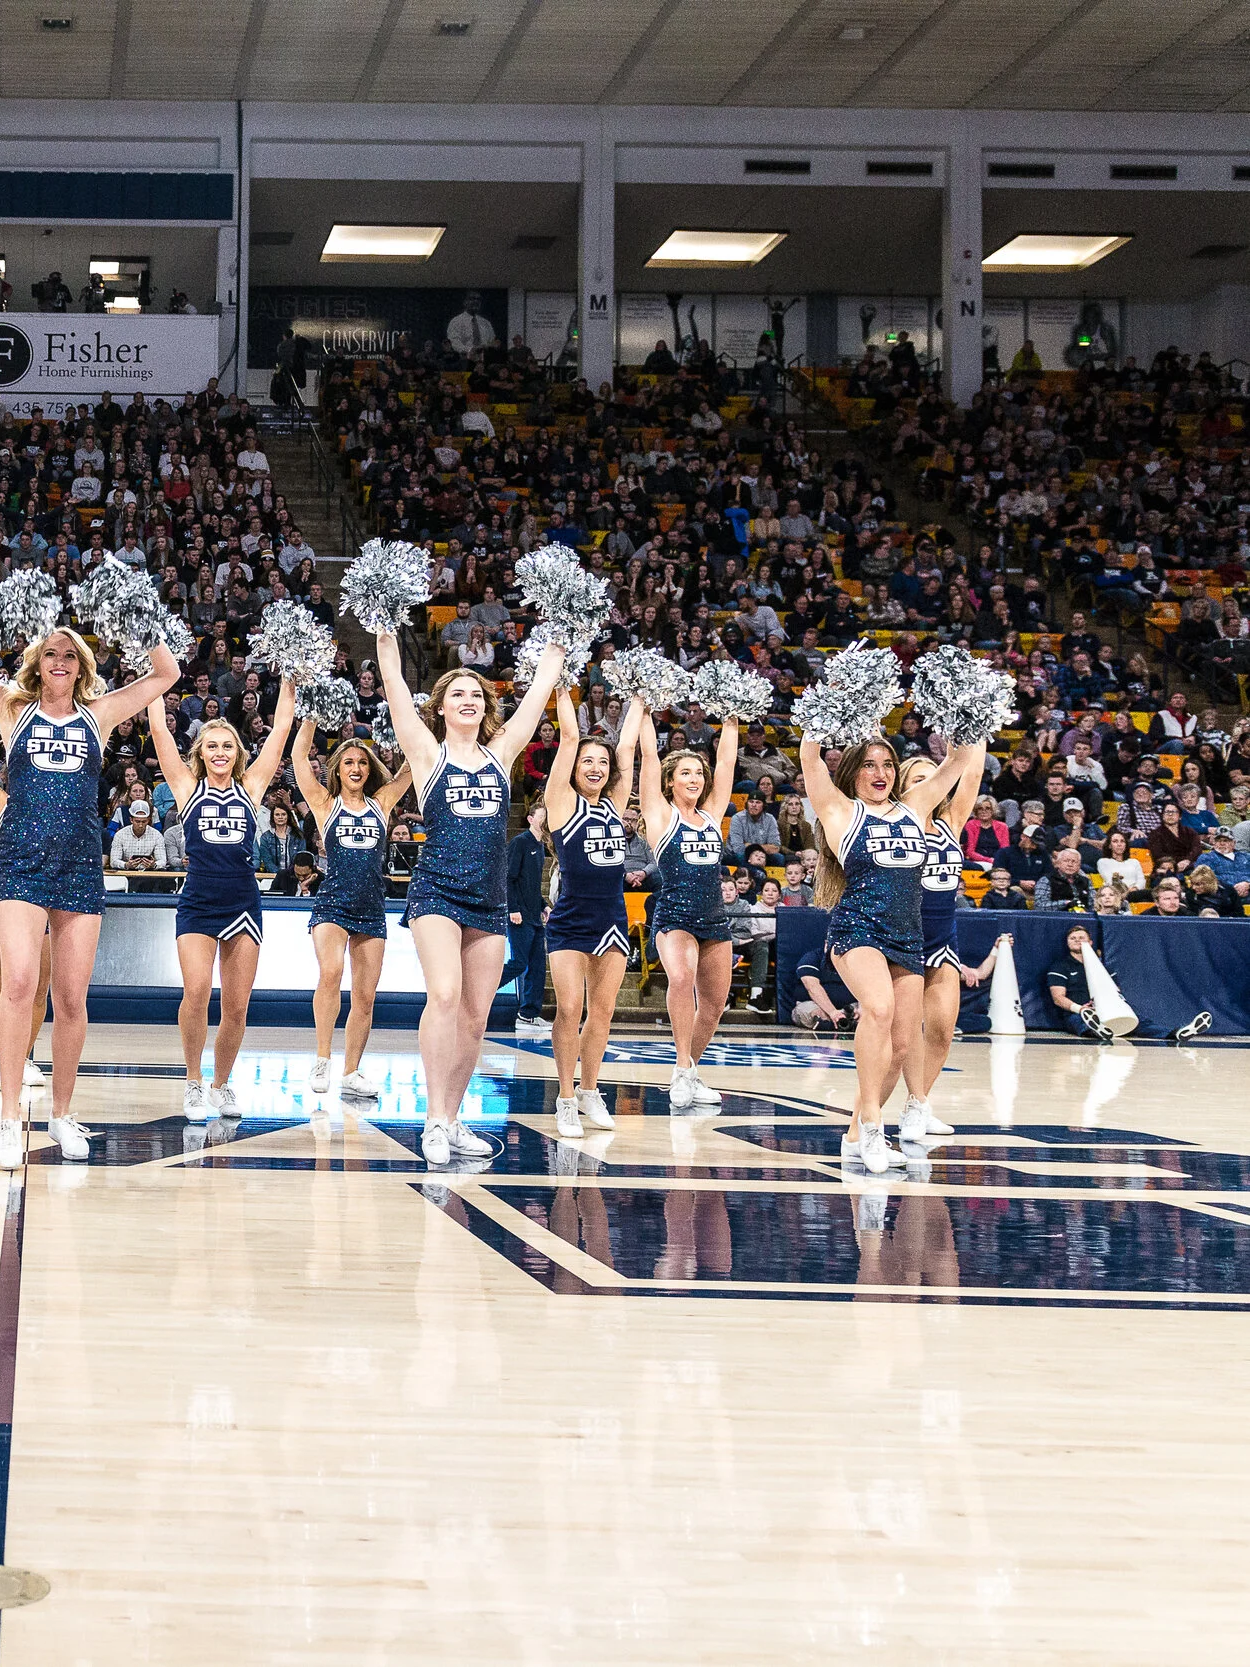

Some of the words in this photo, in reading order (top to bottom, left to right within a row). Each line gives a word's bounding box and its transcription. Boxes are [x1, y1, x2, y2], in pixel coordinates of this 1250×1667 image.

[252, 294, 368, 319] AGGIES
[590, 294, 607, 310] M
[961, 300, 975, 317] N
[44, 331, 148, 363] Fisher
[322, 328, 406, 354] CONSERVIC
[38, 366, 77, 378] Home
[81, 366, 153, 381] Furnishings
[26, 738, 88, 758] STATE
[445, 786, 502, 803] STATE
[197, 817, 247, 831] STATE
[335, 826, 380, 839] STATE
[583, 837, 626, 854] STATE
[680, 841, 722, 854] STATE
[866, 837, 926, 853] STATE
[922, 863, 962, 880] STATE
